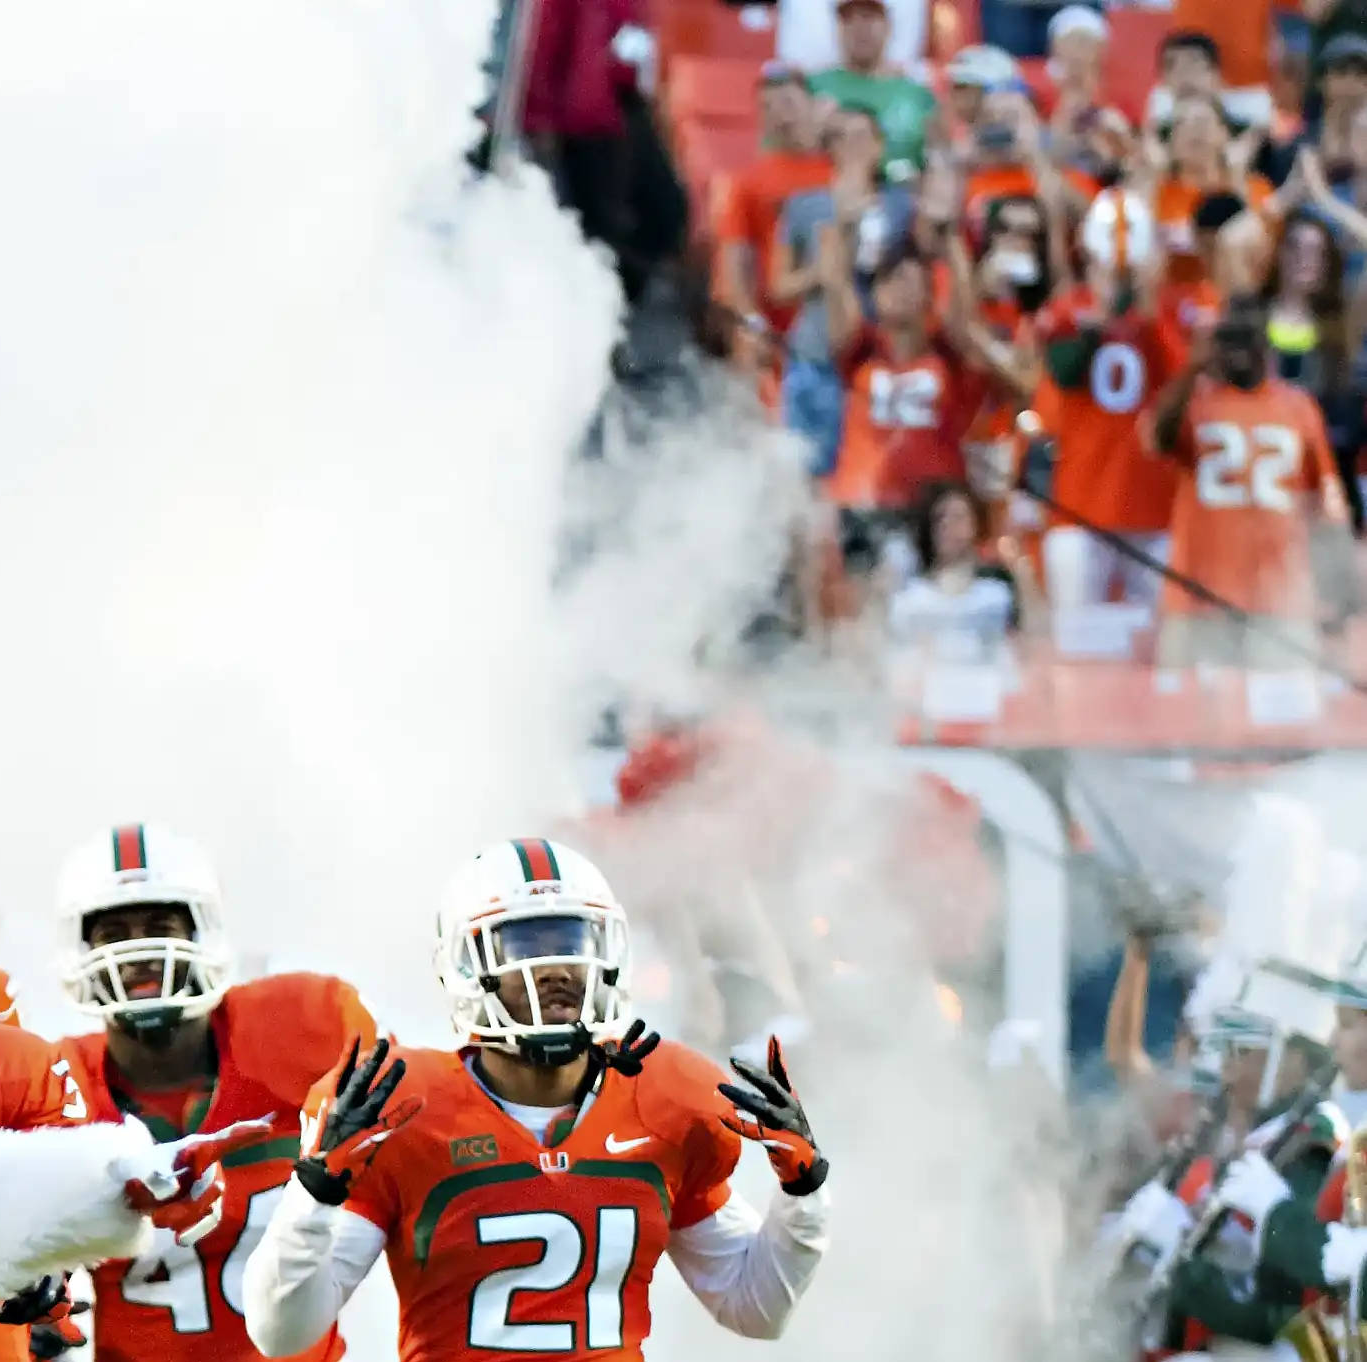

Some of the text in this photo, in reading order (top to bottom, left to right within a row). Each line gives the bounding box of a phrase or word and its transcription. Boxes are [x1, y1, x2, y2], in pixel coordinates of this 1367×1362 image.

[1091, 341, 1146, 413] 0
[1195, 420, 1301, 510] 22
[457, 1139, 496, 1158] ACC
[539, 1151, 569, 1174] U
[468, 1206, 638, 1353] 21
